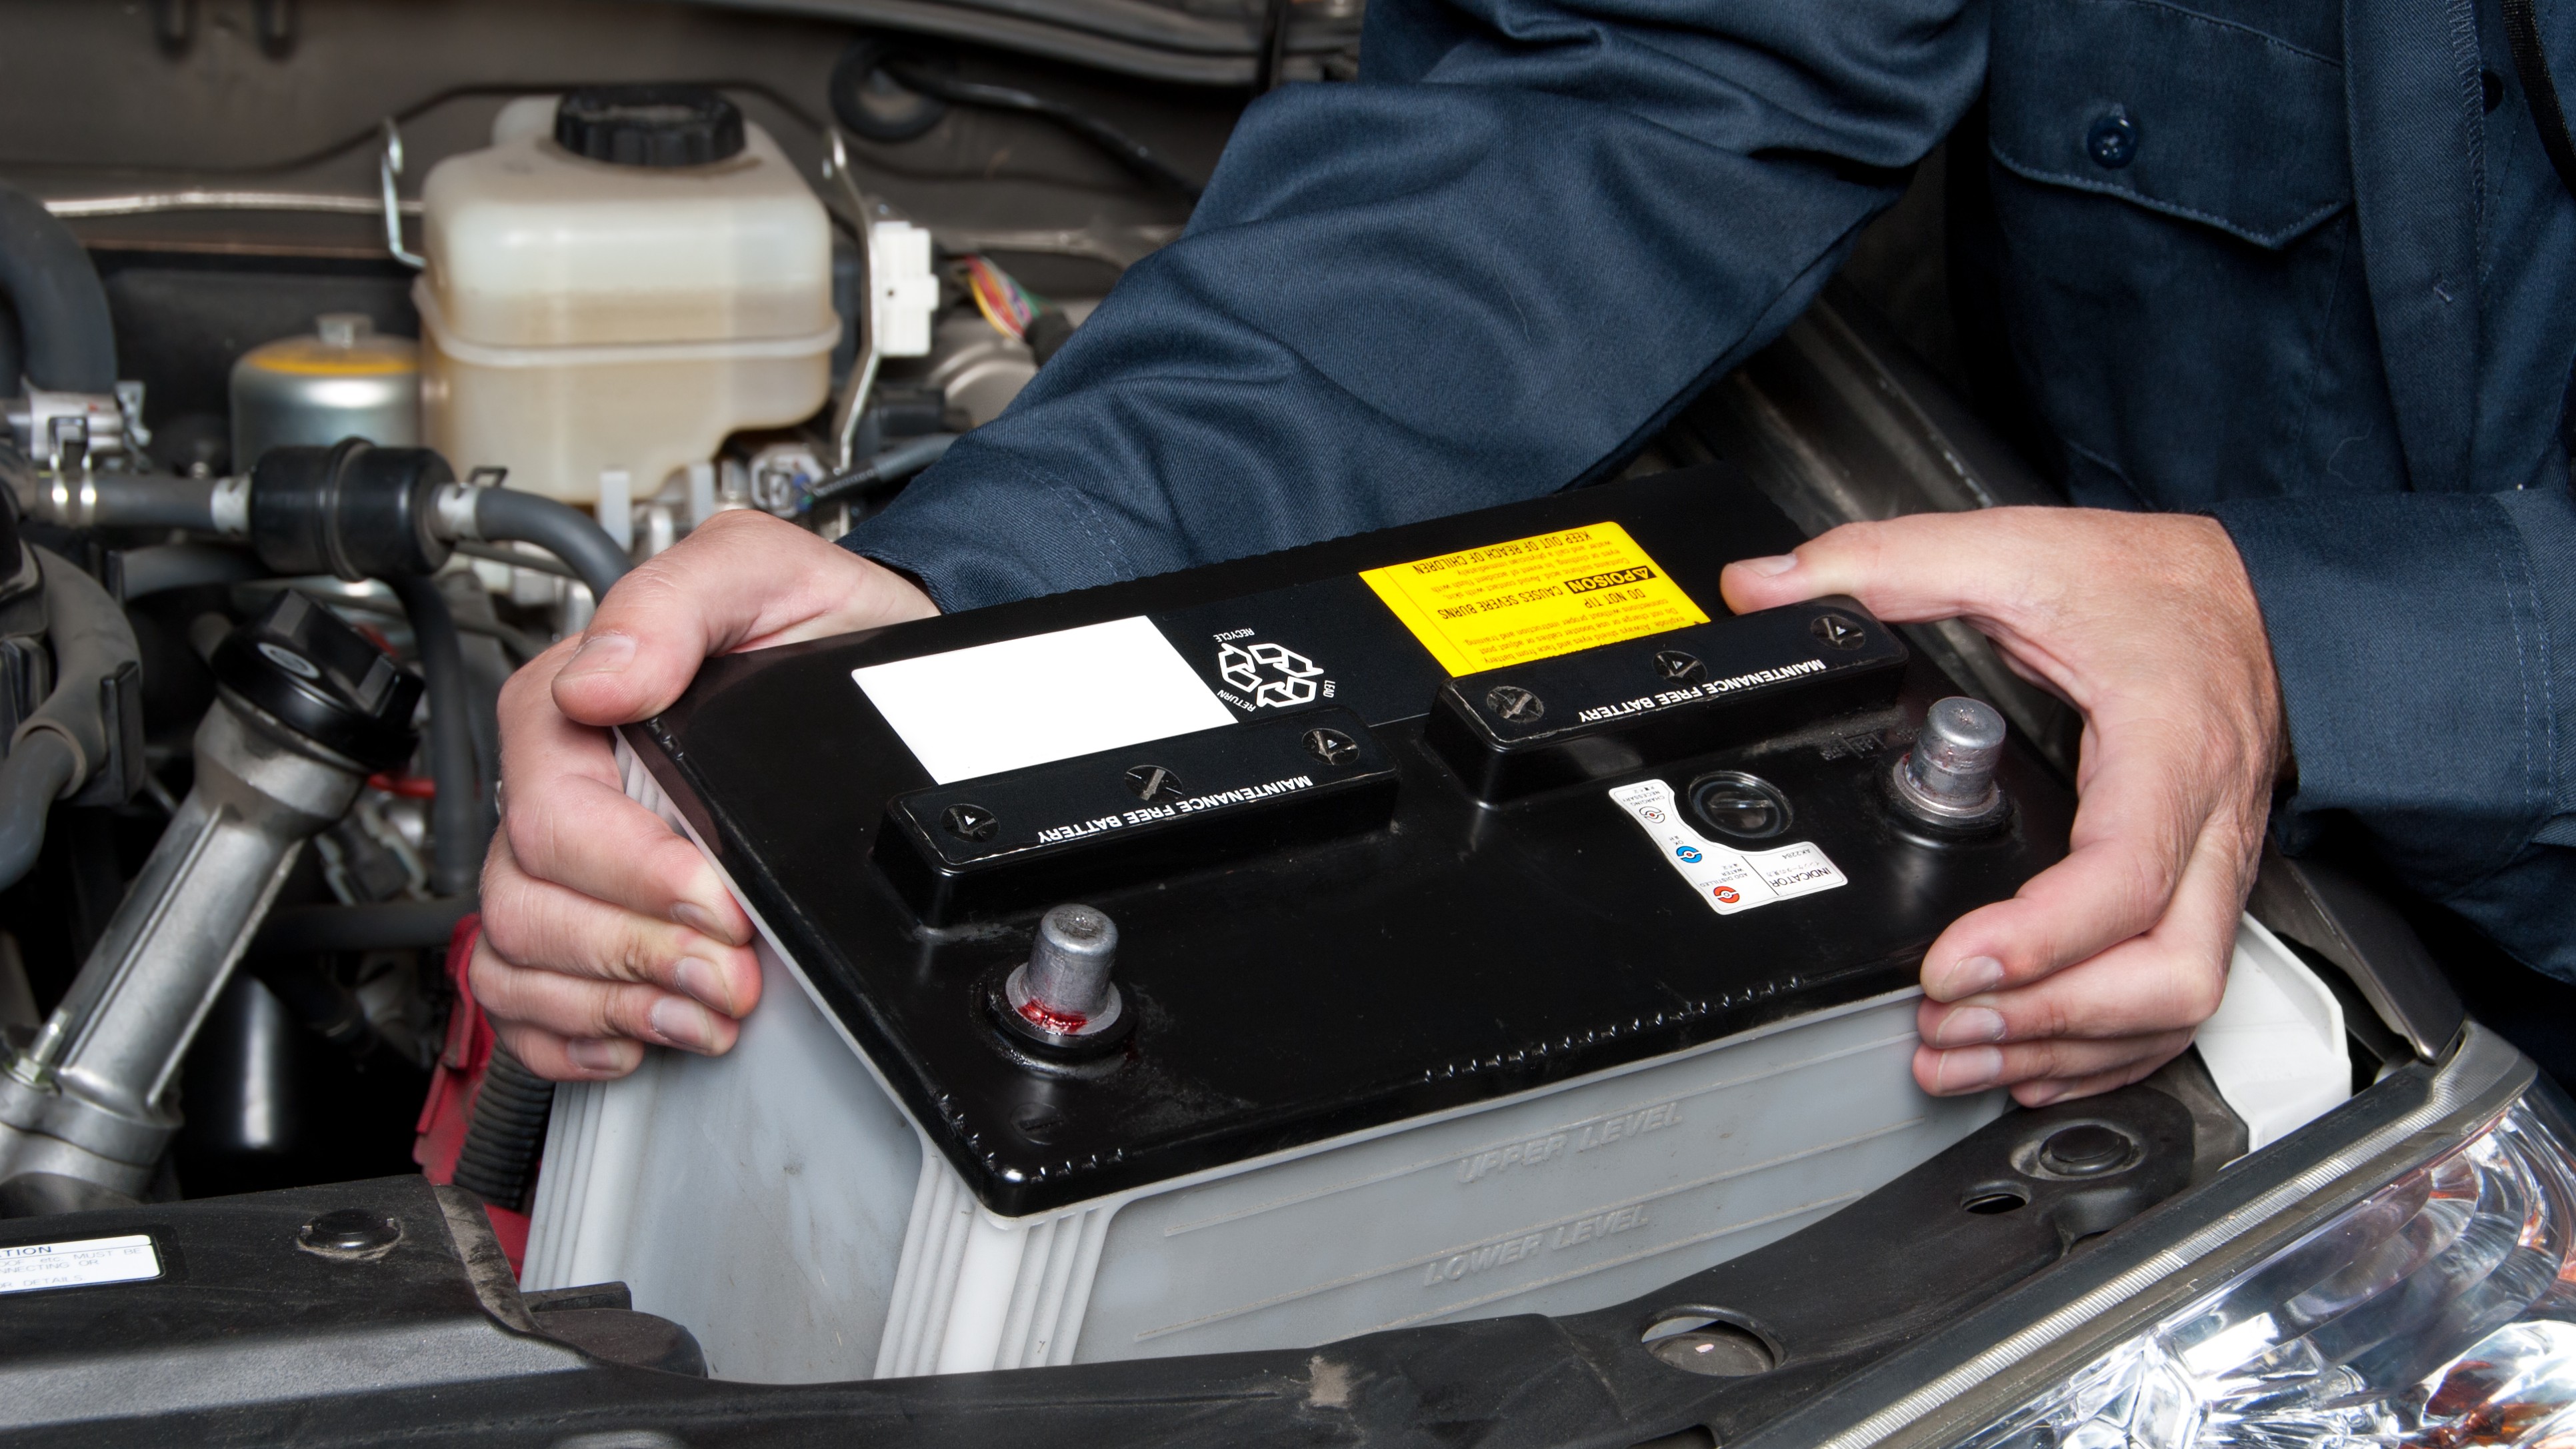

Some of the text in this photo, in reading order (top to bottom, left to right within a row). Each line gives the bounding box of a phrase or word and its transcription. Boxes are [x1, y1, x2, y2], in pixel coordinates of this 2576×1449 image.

[1570, 545, 1586, 554] and
[1589, 541, 1612, 549] water
[1412, 531, 1591, 575] KEEP OUT OF REACH OF CHILDREN
[1555, 548, 1571, 557] call
[1508, 552, 1547, 565] physician
[1593, 557, 1631, 569] Contains
[1520, 564, 1544, 574] event
[1562, 564, 1594, 575] sulfuric
[1475, 571, 1509, 584] accident
[1517, 575, 1541, 586] Avoid
[1431, 584, 1451, 593] with
[1452, 579, 1475, 589] flush
[1485, 581, 1517, 592] contact
[1437, 570, 1637, 619] POISON CAUSES SEVERE BURNS
[1465, 587, 1484, 597] with
[1584, 588, 1646, 609] DO NOT TIP
[1621, 599, 1669, 613] connections
[1562, 614, 1589, 625] proper
[1590, 609, 1621, 620] without
[1621, 613, 1649, 623] charge
[1516, 621, 1560, 635] instruction
[1564, 625, 1597, 636] booster
[1619, 623, 1651, 634] Always
[1213, 628, 1255, 643] RECYCLE
[1499, 631, 1515, 641] and
[1535, 631, 1563, 642] cables
[1573, 636, 1593, 645] eyes
[1593, 630, 1619, 641] shield
[1479, 645, 1498, 655] post
[1499, 640, 1525, 651] adjust
[1556, 640, 1573, 649] and
[1515, 649, 1537, 657] from
[1323, 680, 1336, 698] LEAD
[1578, 659, 1827, 723] MAINTENANCE FREE BATTERY
[1217, 689, 1256, 712] RETURN
[1623, 790, 1661, 802] NECESSARY
[1630, 796, 1665, 806] CHARGING
[1038, 775, 1313, 843] MAINTENANCE FREE BATTERY
[1722, 868, 1743, 876] WATER
[1769, 867, 1832, 887] INDICATOR
[1699, 876, 1734, 887] DISTILLED
[1458, 1102, 1683, 1184] UPPER LEVEL
[0, 1246, 52, 1257] TION
[1423, 1205, 1649, 1287] LOWER LEVEL
